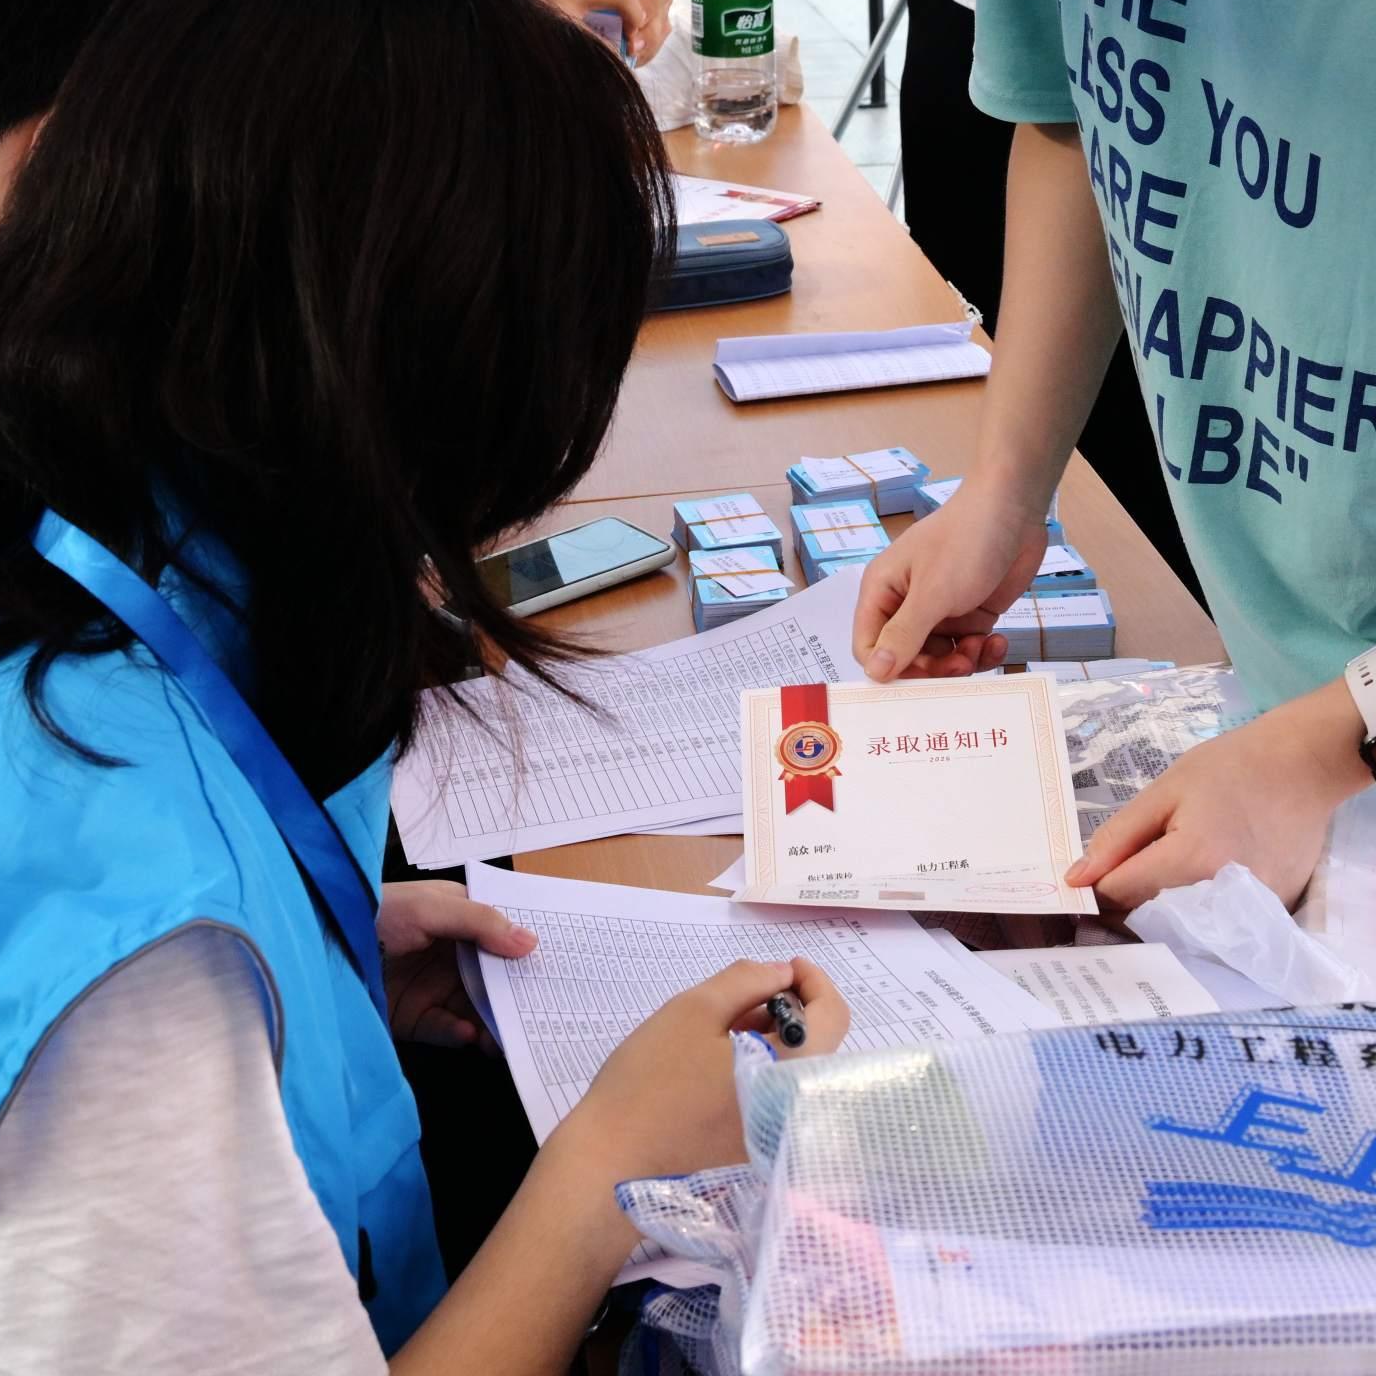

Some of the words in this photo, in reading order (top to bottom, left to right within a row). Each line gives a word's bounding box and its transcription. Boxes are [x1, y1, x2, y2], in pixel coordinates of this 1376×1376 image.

[1201, 78, 1322, 228] YOU
[867, 727, 1009, 756] 录取通知书
[916, 858, 970, 873] 电力工程系
